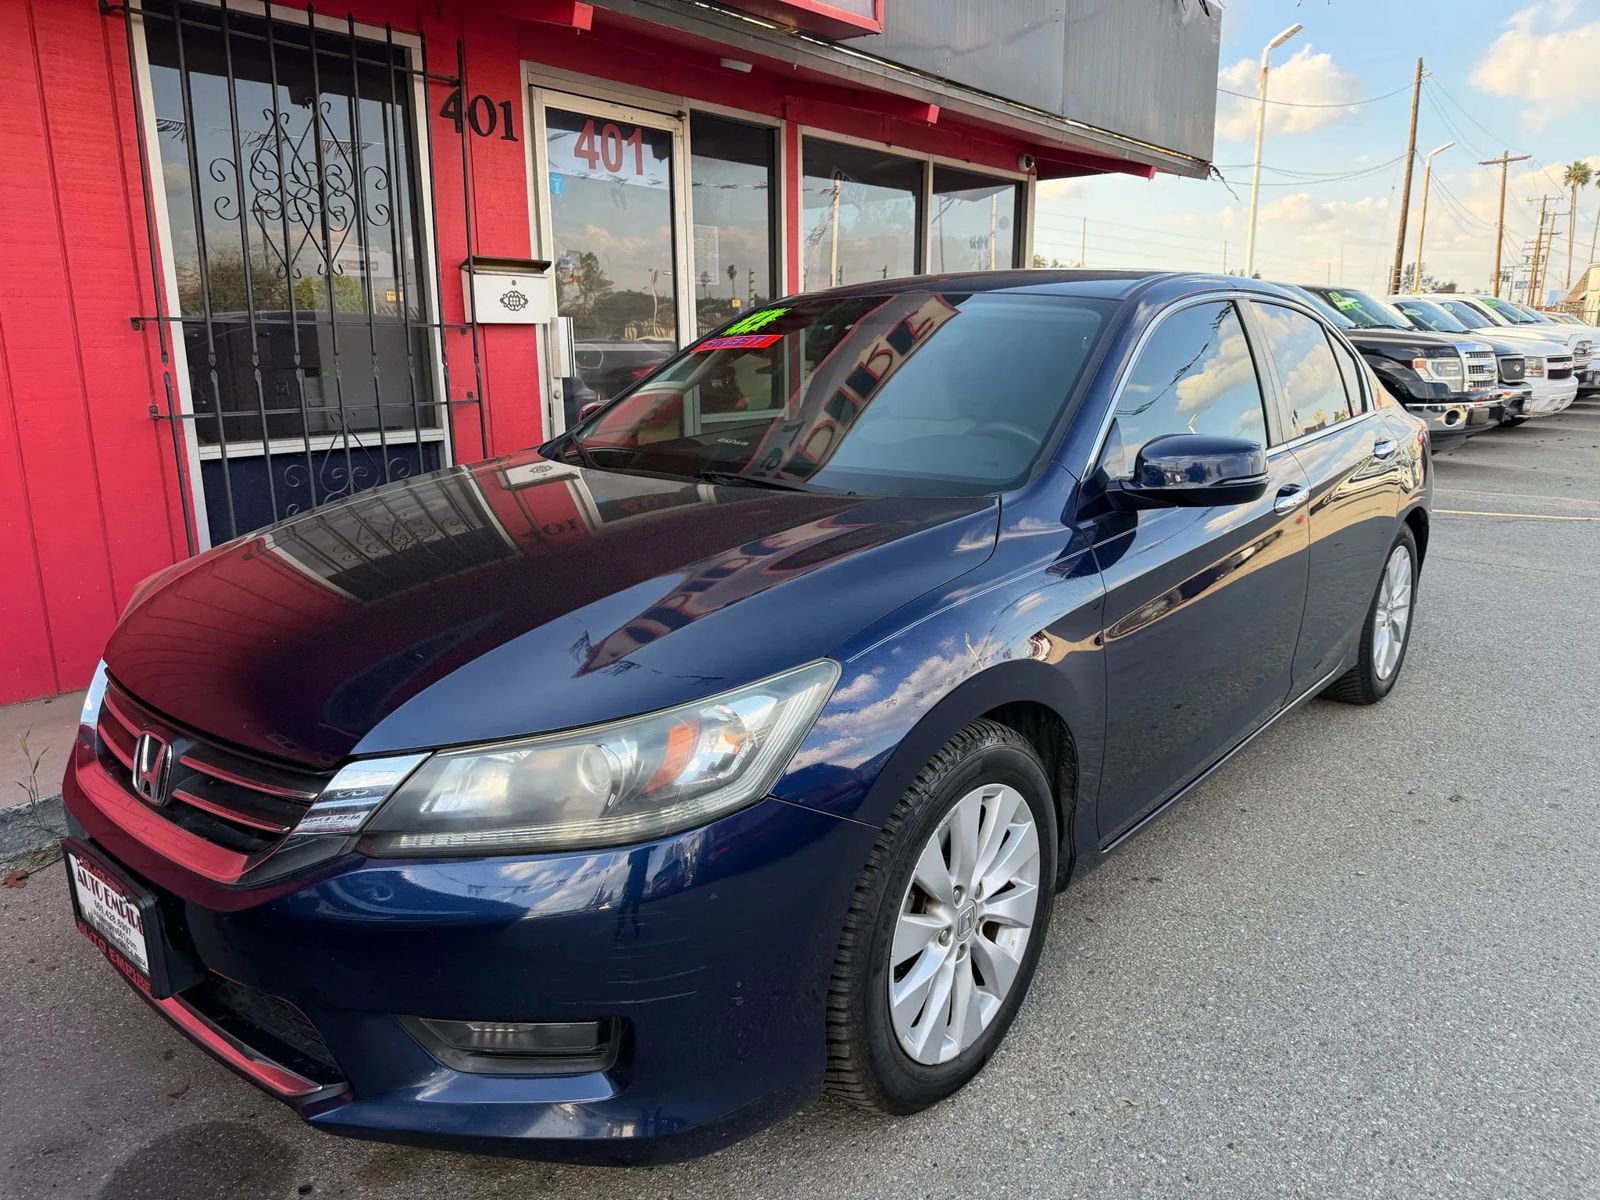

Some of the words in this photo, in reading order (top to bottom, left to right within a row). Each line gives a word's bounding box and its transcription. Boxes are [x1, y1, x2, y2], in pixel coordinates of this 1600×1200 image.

[439, 88, 519, 142] 401
[573, 119, 644, 176] 401
[78, 866, 104, 901] AUTO
[76, 919, 107, 954] AUTO
[108, 947, 151, 994] EMPIRE
